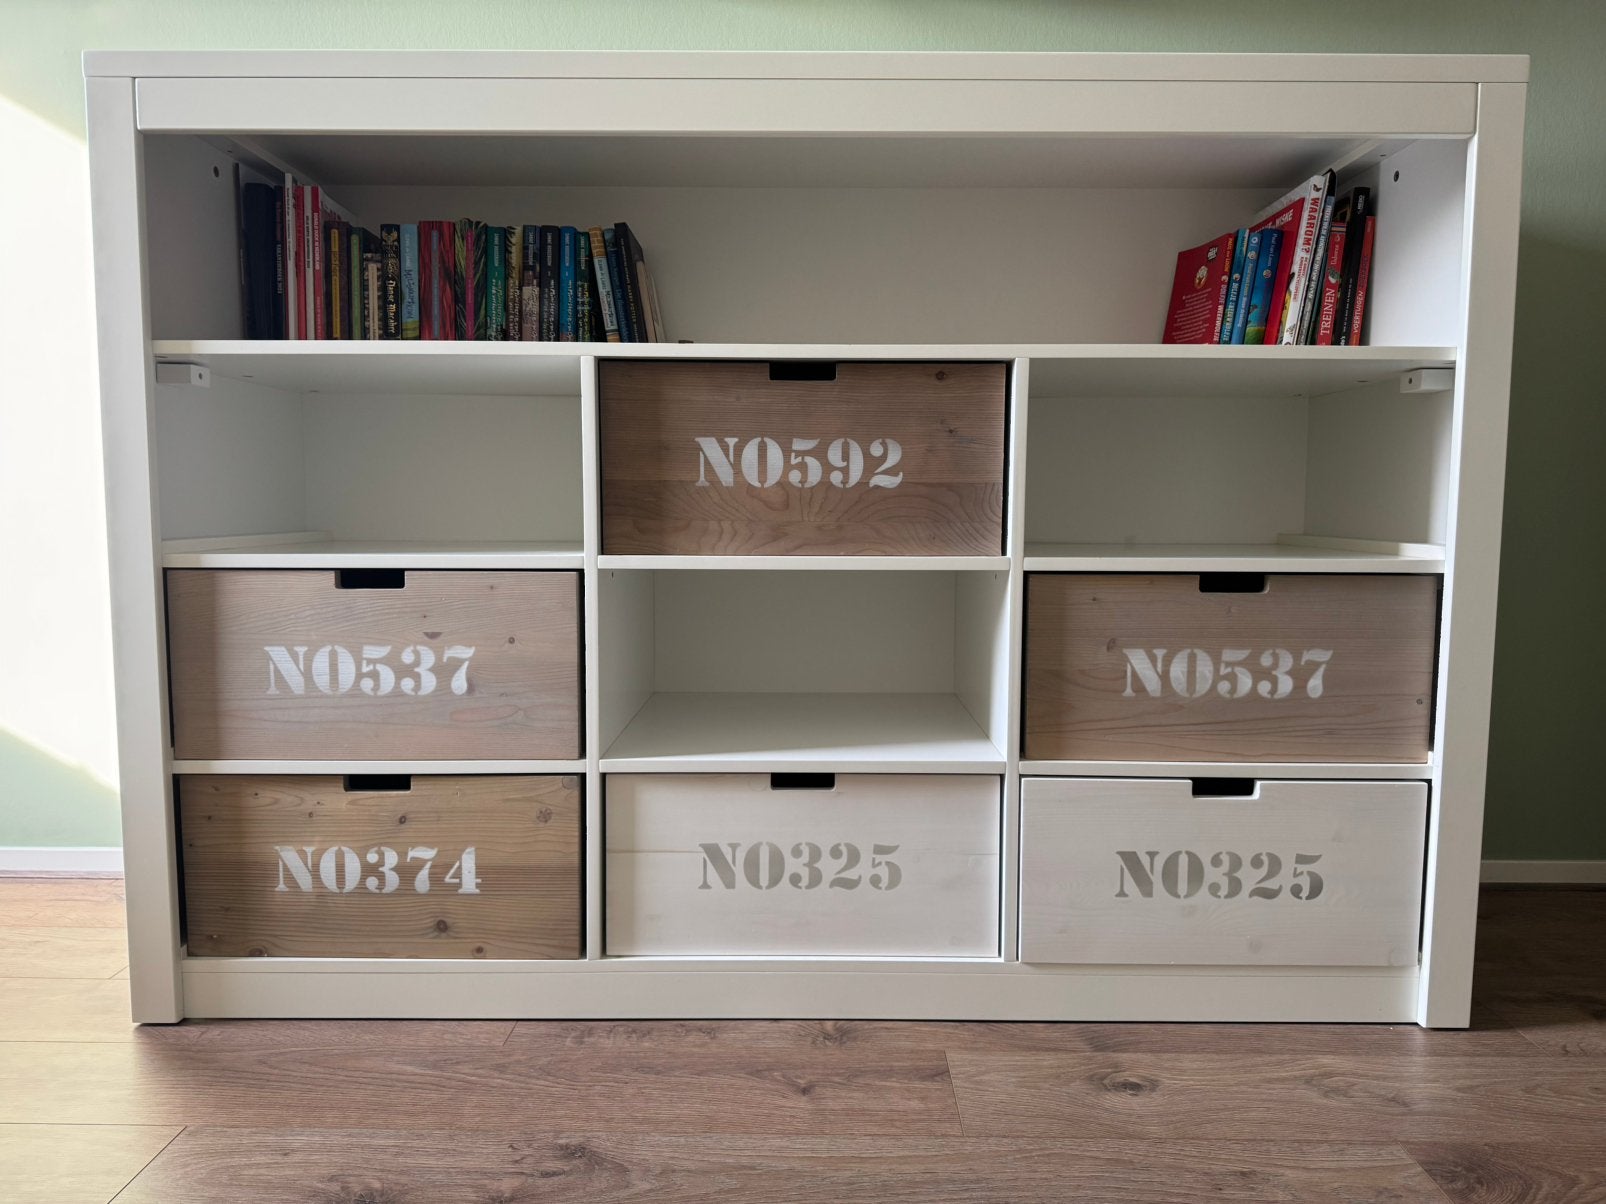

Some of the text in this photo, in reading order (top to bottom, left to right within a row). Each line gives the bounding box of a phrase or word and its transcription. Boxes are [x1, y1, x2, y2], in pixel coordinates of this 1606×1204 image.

[1303, 197, 1320, 254] WAAROM?
[1320, 288, 1335, 335] TREINEN
[1353, 291, 1363, 334] VOERTUIGEN
[695, 437, 903, 490] NO592
[263, 645, 476, 696] NO537
[1122, 648, 1333, 699] NO537
[274, 845, 482, 894] NO374
[698, 842, 902, 891] NO325
[1115, 850, 1324, 901] NO325
